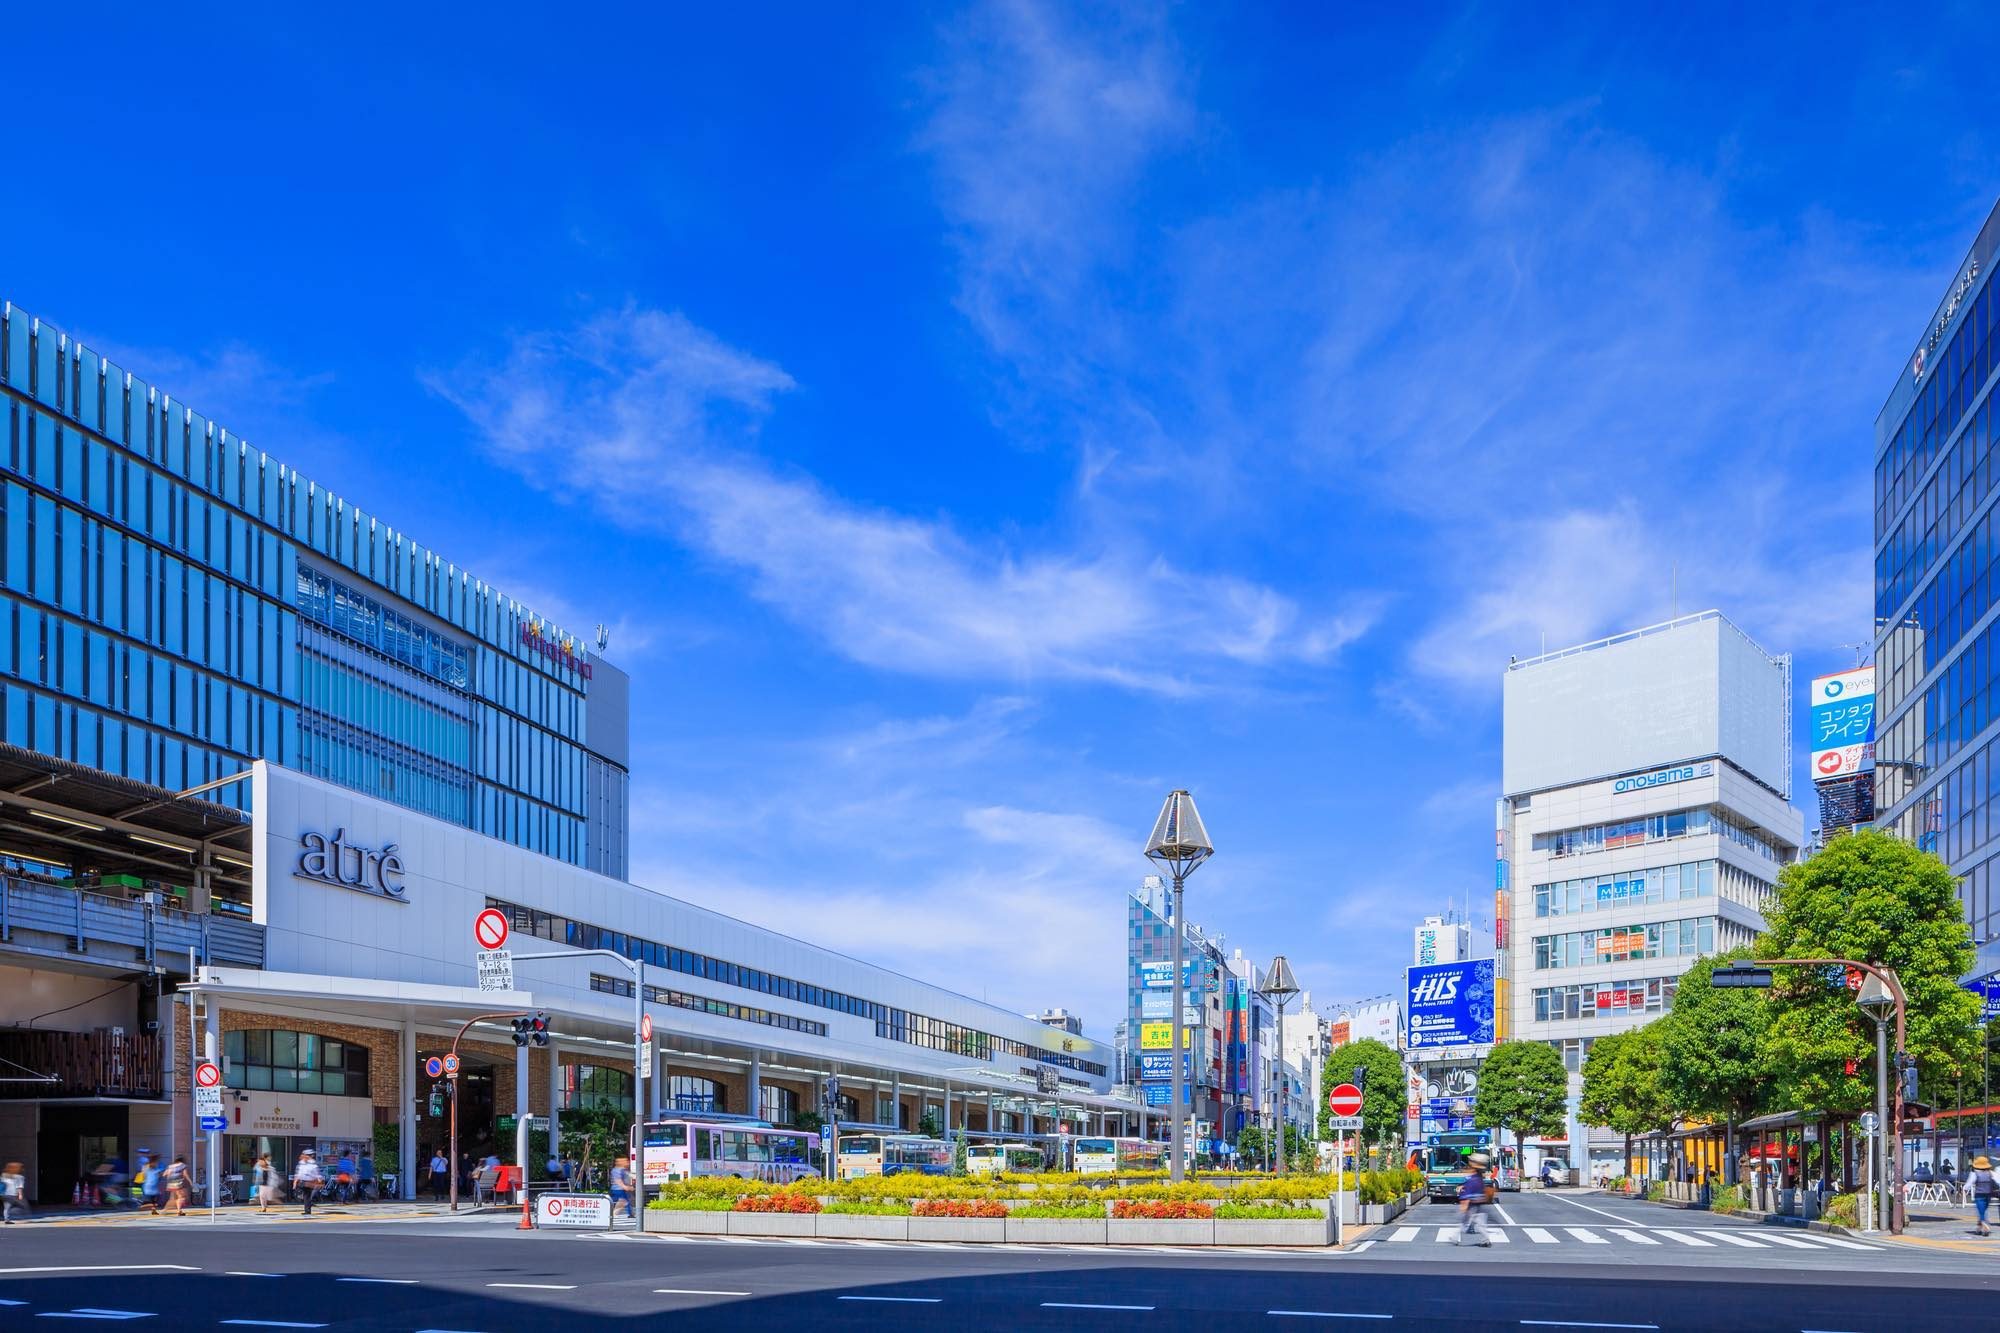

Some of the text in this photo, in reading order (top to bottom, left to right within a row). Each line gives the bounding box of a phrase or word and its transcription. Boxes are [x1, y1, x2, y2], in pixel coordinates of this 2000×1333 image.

[1820, 703, 1874, 723] コンタク
[1820, 717, 1871, 742] アイシ
[1845, 762, 1857, 771] 3F
[1615, 766, 1694, 792] onoyama
[301, 827, 405, 896] atré
[446, 1059, 455, 1068] 30
[824, 1126, 830, 1138] P
[564, 1199, 601, 1208] 車両通行止
